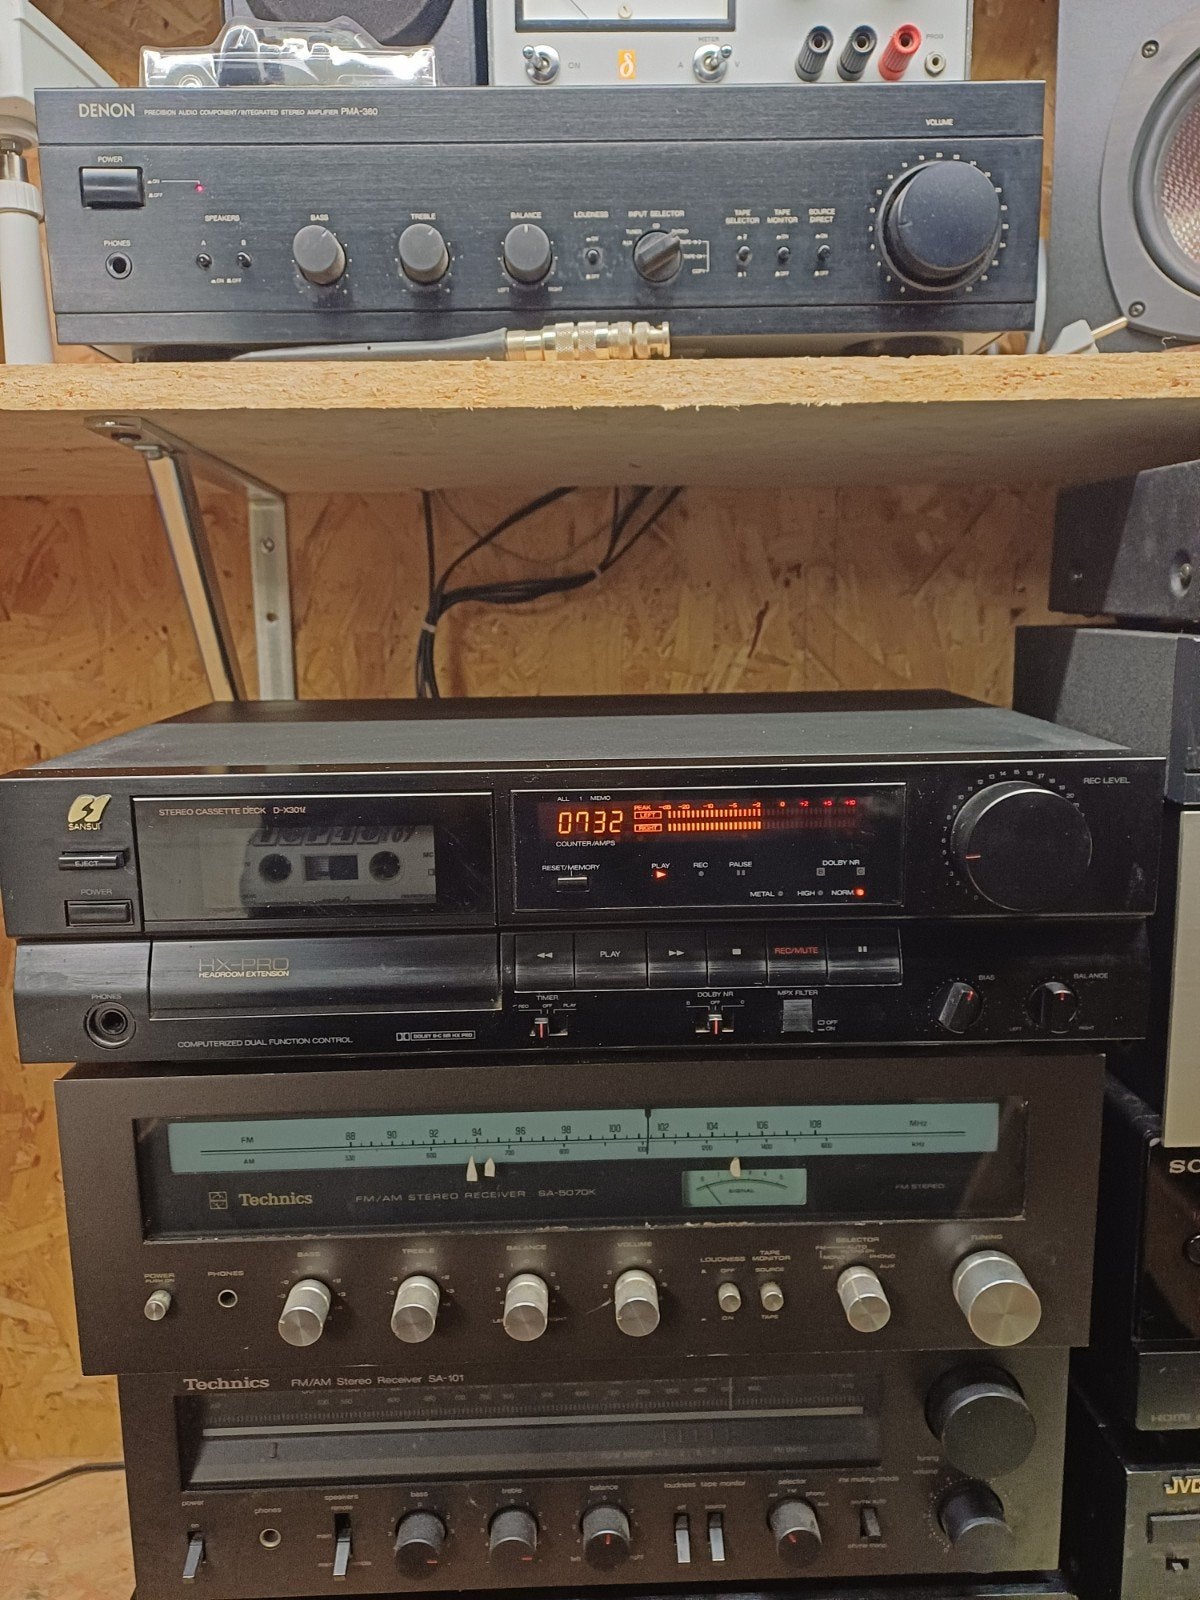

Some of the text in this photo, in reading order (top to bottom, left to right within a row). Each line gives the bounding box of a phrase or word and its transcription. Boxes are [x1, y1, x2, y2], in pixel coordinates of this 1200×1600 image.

[79, 103, 136, 117] DENON
[926, 118, 954, 126] VOLUME
[510, 211, 542, 220] BALANCE
[573, 210, 609, 219] LOUDNESS
[627, 209, 685, 218] INPUT SELECTOR
[808, 208, 836, 216] SOURCE
[204, 214, 240, 222] SPEAKERS
[310, 214, 329, 222] BASS
[411, 212, 437, 221] TREBLE
[725, 216, 760, 225] SELECTOR
[766, 216, 799, 224] MONITOR
[104, 239, 131, 247] PHONES
[1083, 777, 1103, 785] REC
[158, 808, 194, 816] STEREO
[195, 807, 241, 815] CASSETTE
[242, 807, 267, 815] DECK
[558, 810, 624, 834] 0732
[556, 840, 616, 848] COUNTER/AMPS
[75, 860, 99, 868] EJECT
[651, 862, 671, 870] PLAY
[693, 861, 709, 869] REC
[822, 859, 847, 867] DOLBY
[541, 863, 601, 872] RESET/MEMORY
[80, 888, 113, 896] POWER
[599, 950, 621, 958] PLAY
[774, 946, 819, 955] REC/MUTE
[198, 957, 290, 972] HX-PRO
[198, 970, 290, 979] HEADROOM EXTENSION
[1073, 972, 1109, 980] BALANCE
[177, 1036, 353, 1048] COMPUTERIZED DUAL FUNCTION CONTROL
[345, 1131, 356, 1141] 88
[386, 1130, 398, 1139] 90
[428, 1128, 439, 1138] 92
[471, 1127, 482, 1137] 94
[515, 1126, 526, 1136] 96
[561, 1125, 572, 1135] 98
[609, 1123, 621, 1133] 100
[657, 1122, 670, 1132] 102
[706, 1121, 719, 1131] 104
[757, 1120, 769, 1130] 106
[809, 1119, 822, 1129] 108
[238, 1191, 313, 1207] Technics
[355, 1194, 402, 1203] FM/AM
[408, 1192, 458, 1201] STEREO
[464, 1190, 526, 1199] RECEIVER
[183, 1373, 465, 1391] Technics FM/AM Stereo Receiver SA-101
[663, 1481, 696, 1489] loudness
[324, 1493, 359, 1501] speakers
[254, 1506, 282, 1515] phones
